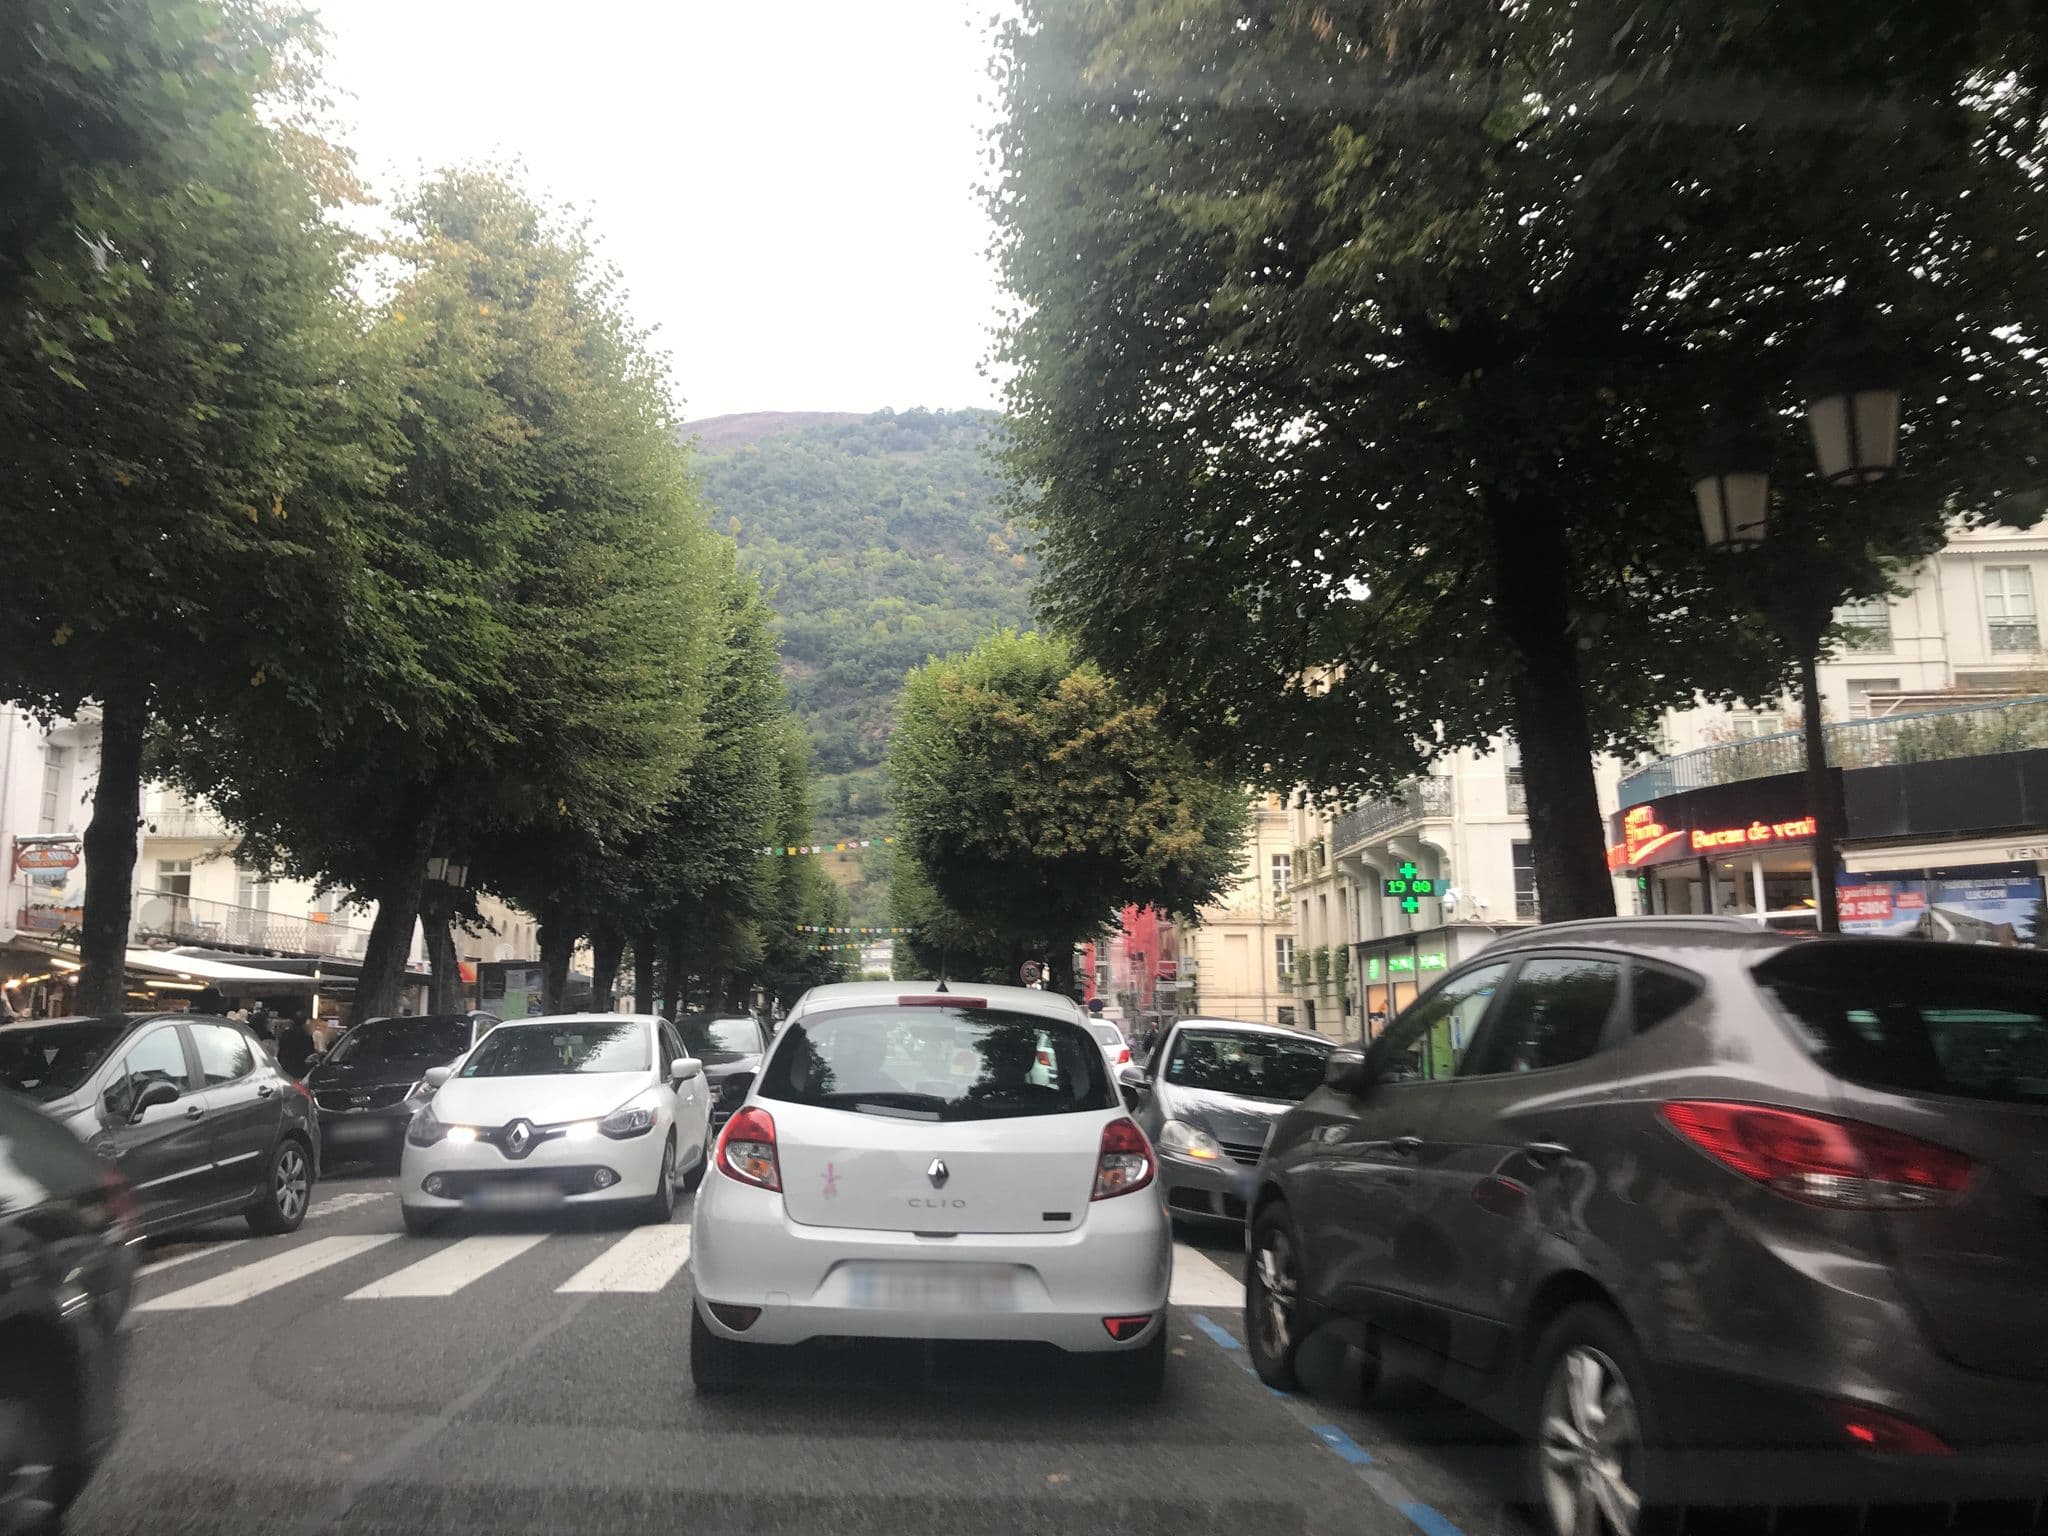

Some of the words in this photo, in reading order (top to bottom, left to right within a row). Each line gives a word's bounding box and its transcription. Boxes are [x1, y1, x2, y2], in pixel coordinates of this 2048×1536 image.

[1691, 829, 1746, 849] Bureau
[1747, 821, 1772, 841] de
[1387, 880, 1407, 893] 19
[1412, 880, 1432, 893] 00
[1025, 967, 1036, 978] 30
[908, 1198, 967, 1209] CLIO
